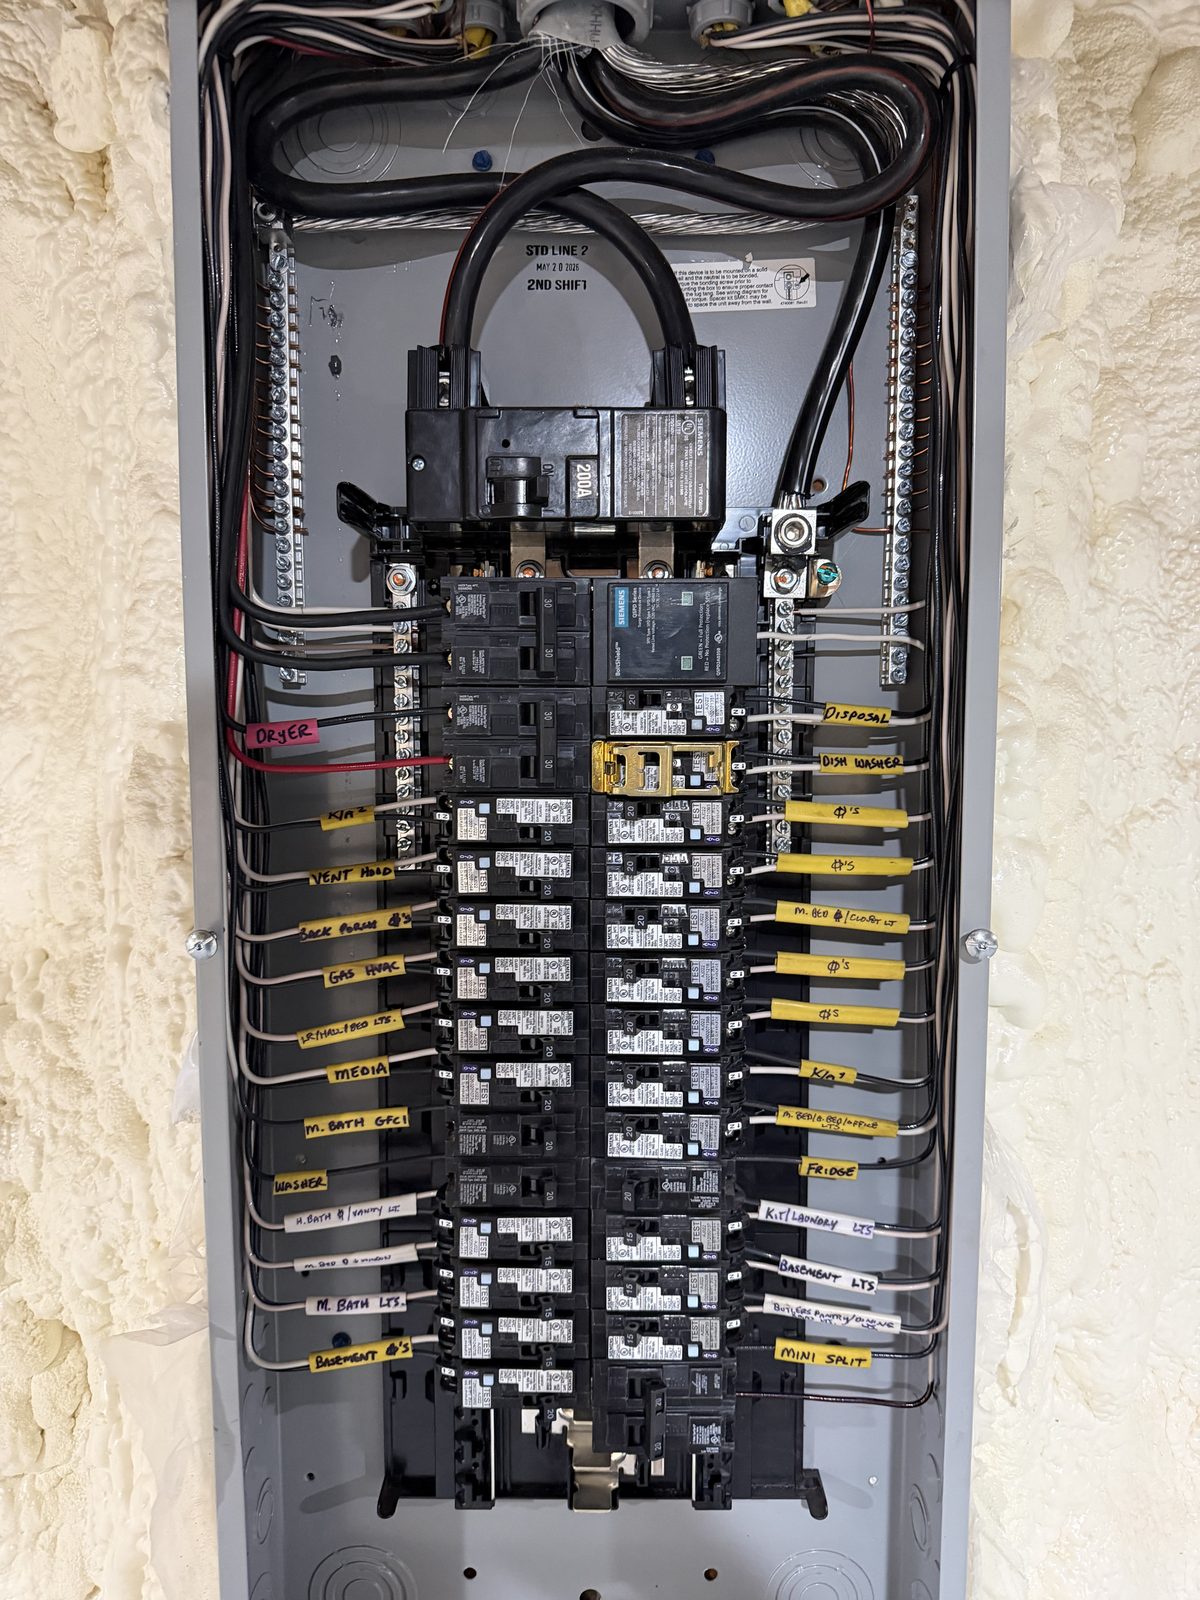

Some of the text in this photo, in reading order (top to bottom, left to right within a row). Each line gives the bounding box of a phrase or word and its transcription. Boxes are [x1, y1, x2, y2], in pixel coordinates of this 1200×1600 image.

[526, 245, 588, 256] STD LINE 2
[537, 263, 550, 272] MAY
[566, 264, 579, 272] 2026
[528, 279, 586, 290] 2ND SHIFT
[576, 464, 592, 498] 200A
[544, 599, 552, 608] 30
[545, 649, 553, 657] 30
[628, 695, 636, 705] 20
[544, 712, 552, 720] 30
[824, 708, 890, 724] DISPOSAL
[544, 760, 553, 769] 30
[822, 755, 902, 768] DISH WASHER
[627, 806, 634, 816] 20
[545, 831, 552, 841] 20
[627, 861, 633, 871] 20
[312, 866, 392, 884] VENT HOOD
[544, 885, 551, 895] 20
[638, 915, 644, 926] 20
[300, 927, 332, 940] BACK
[340, 920, 377, 935] PORCH
[544, 938, 551, 949] 20
[329, 961, 400, 984] GAS HVAC
[626, 969, 633, 979] 20
[544, 992, 551, 1003] 20
[627, 1021, 633, 1032] 20
[545, 1046, 552, 1057] 20
[335, 1062, 388, 1080] MEDIA
[627, 1074, 633, 1084] 20
[544, 1100, 551, 1110] 20
[306, 1115, 407, 1136] M. BATH GFCI
[626, 1126, 633, 1137] 20
[546, 1142, 553, 1150] 20
[807, 1163, 856, 1177] FRIDGE
[275, 1177, 326, 1192] WASHER
[546, 1192, 553, 1200] 20
[625, 1192, 632, 1201] 20
[853, 1222, 874, 1236] LTS
[626, 1232, 633, 1242] 15
[545, 1256, 551, 1266] 15
[780, 1258, 842, 1282] BASEMENT
[626, 1283, 633, 1294] 15
[316, 1300, 331, 1312] M.
[336, 1298, 369, 1312] BATH
[544, 1308, 551, 1318] 15
[626, 1333, 633, 1344] 15
[316, 1350, 378, 1369] BASEMENT
[545, 1357, 552, 1367] 15
[781, 1348, 867, 1367] MINI SPLIT
[547, 1409, 553, 1419] 20
[655, 1442, 662, 1452] 20
